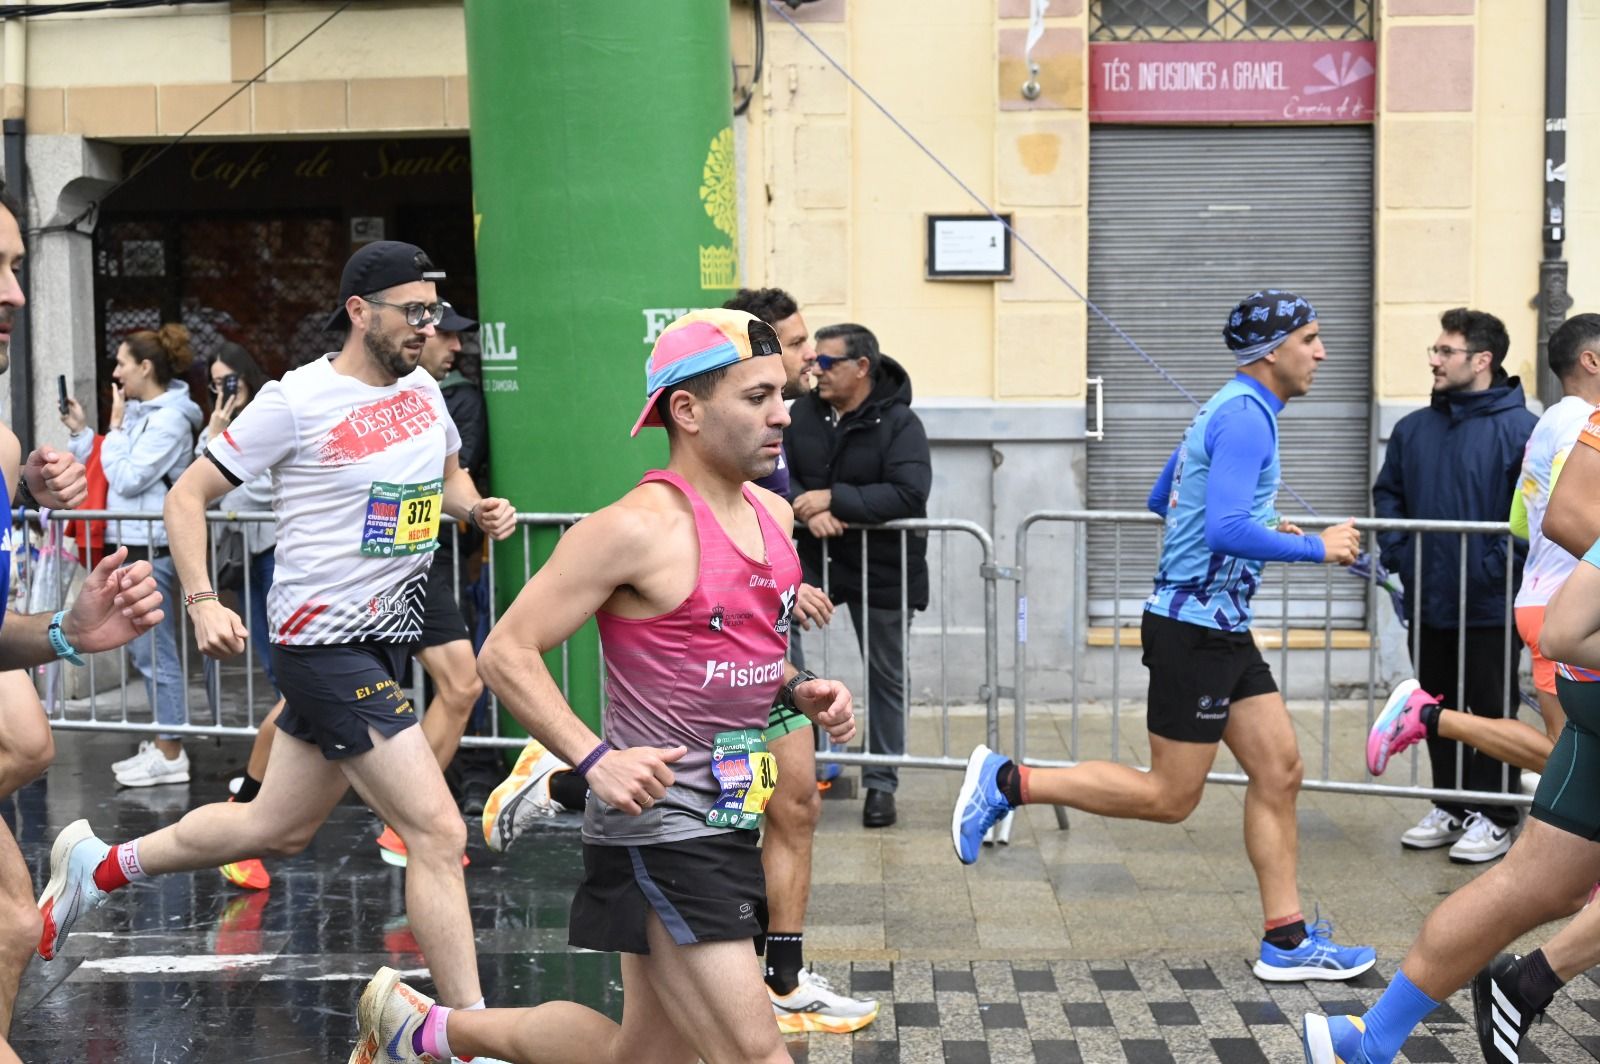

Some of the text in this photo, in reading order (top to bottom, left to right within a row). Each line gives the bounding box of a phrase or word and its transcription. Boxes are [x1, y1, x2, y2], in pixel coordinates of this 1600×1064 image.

[1138, 60, 1217, 91] INFUSIONES
[189, 144, 273, 190] Café
[295, 146, 332, 178] de
[346, 407, 365, 422] LA
[349, 395, 426, 439] DESPENSA
[380, 427, 402, 444] DE
[408, 499, 432, 525] 372
[408, 528, 430, 541] HÉCTOR
